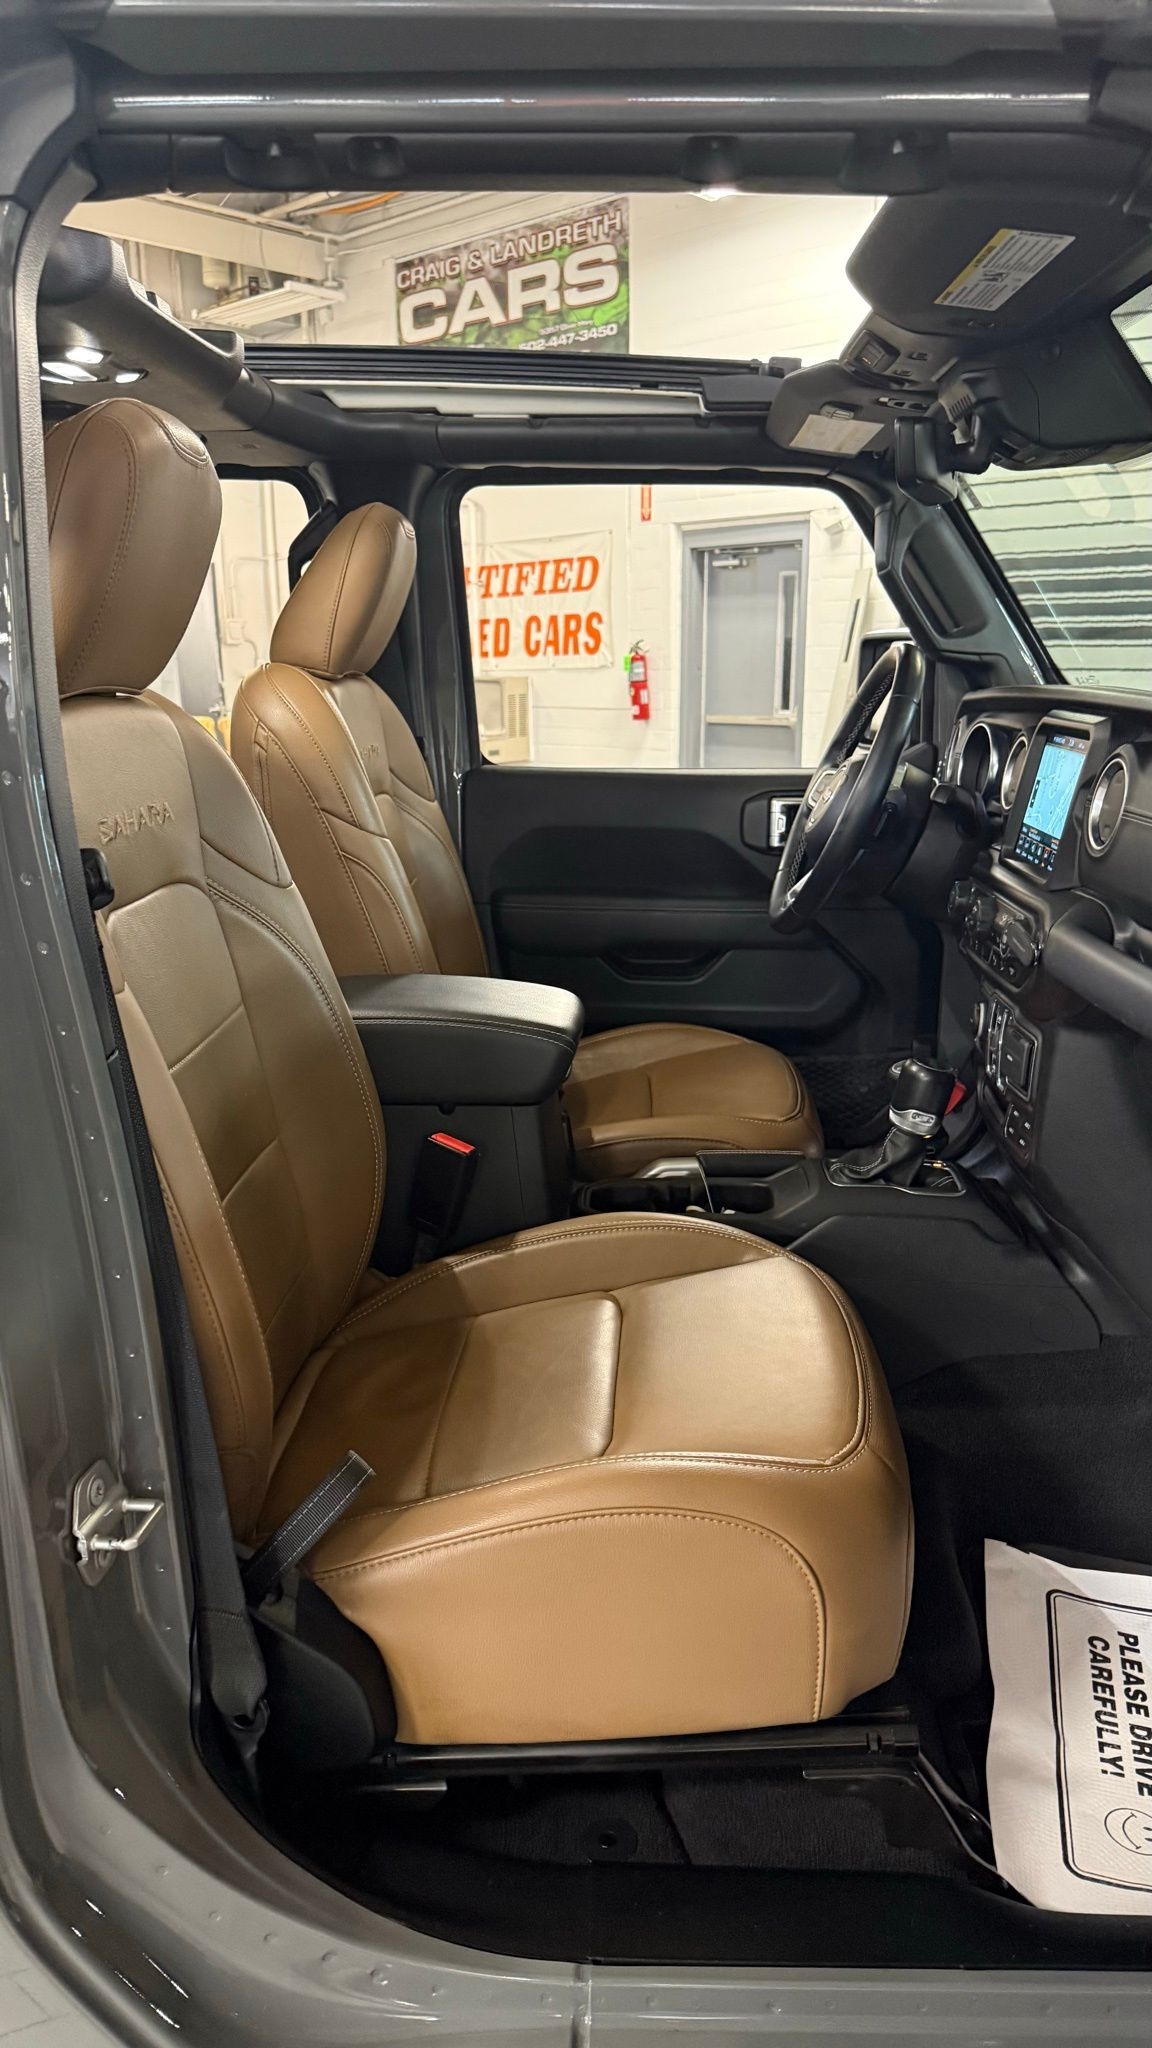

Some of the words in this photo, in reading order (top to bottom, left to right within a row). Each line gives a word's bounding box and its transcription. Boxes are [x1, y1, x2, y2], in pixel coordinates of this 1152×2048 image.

[396, 256, 461, 290] CRAIG
[467, 250, 484, 272] &
[490, 210, 623, 266] LANDRETH
[398, 242, 621, 345] CARS
[523, 611, 603, 658] CARS
[97, 801, 175, 845] SAHARA
[1087, 1635, 1126, 1779] CAREFULLY!
[1117, 1631, 1150, 1718] PLEASE
